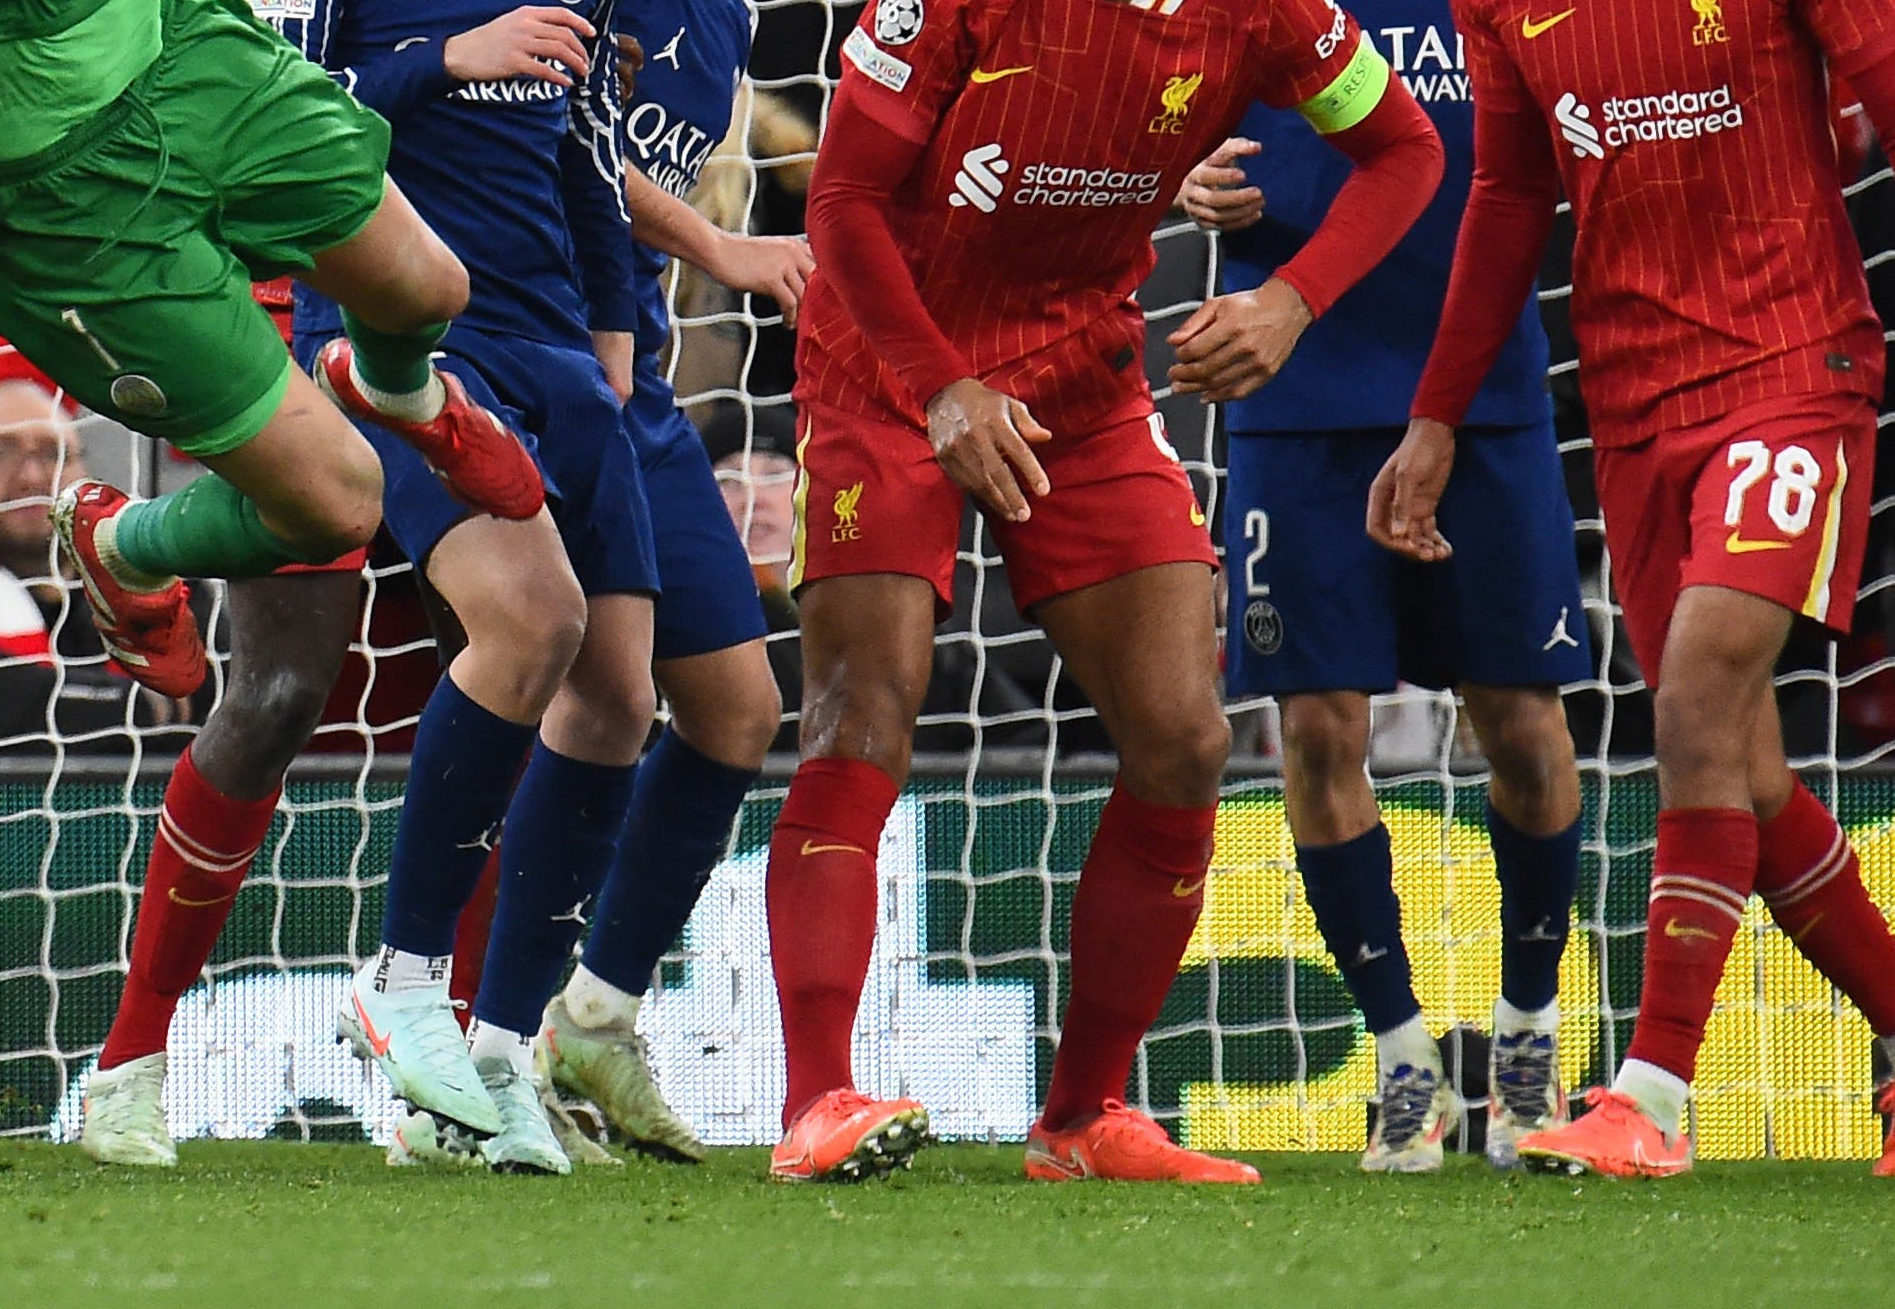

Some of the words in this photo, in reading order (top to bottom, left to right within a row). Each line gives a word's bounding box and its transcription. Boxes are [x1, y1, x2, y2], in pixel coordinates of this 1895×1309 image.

[1602, 84, 1731, 123] standard
[1604, 103, 1743, 147] chartered
[1013, 186, 1160, 207] chartered
[1020, 161, 1162, 189] standard
[61, 308, 122, 372] 1
[1724, 439, 1822, 537] 78
[1244, 509, 1271, 598] 2
